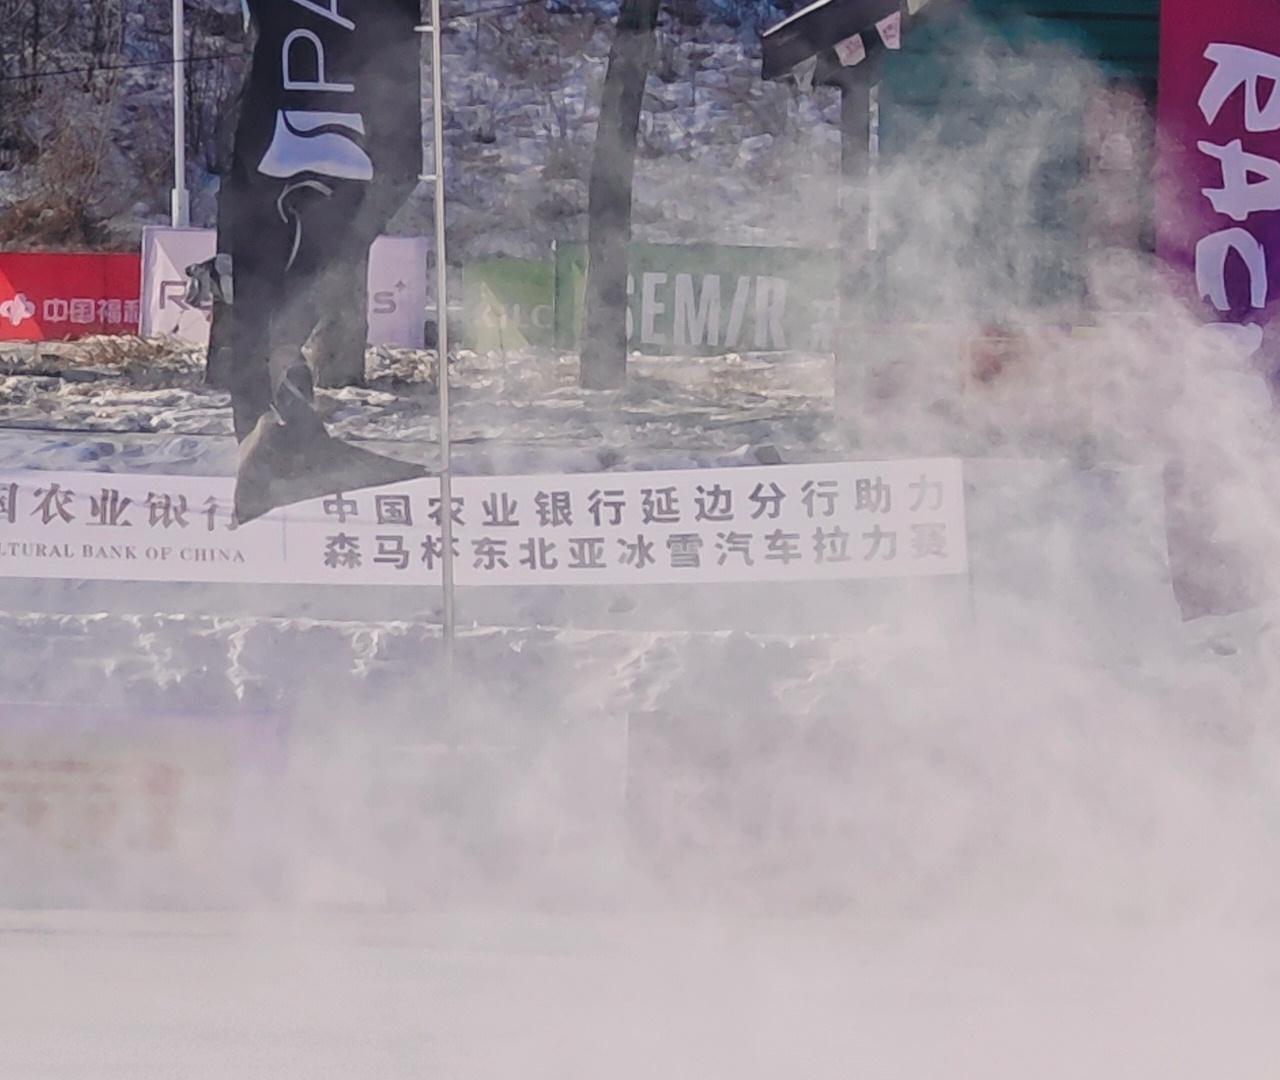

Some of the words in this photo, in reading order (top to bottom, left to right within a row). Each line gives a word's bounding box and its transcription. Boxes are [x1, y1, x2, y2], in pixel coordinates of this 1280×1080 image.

[323, 474, 945, 528] 中国农业银行延边分行助力
[82, 544, 138, 560] BANK
[145, 547, 169, 561] OF
[180, 547, 246, 563] CHINA
[323, 522, 947, 570] 森马杯东北亚冰雪汽车拉力赛
